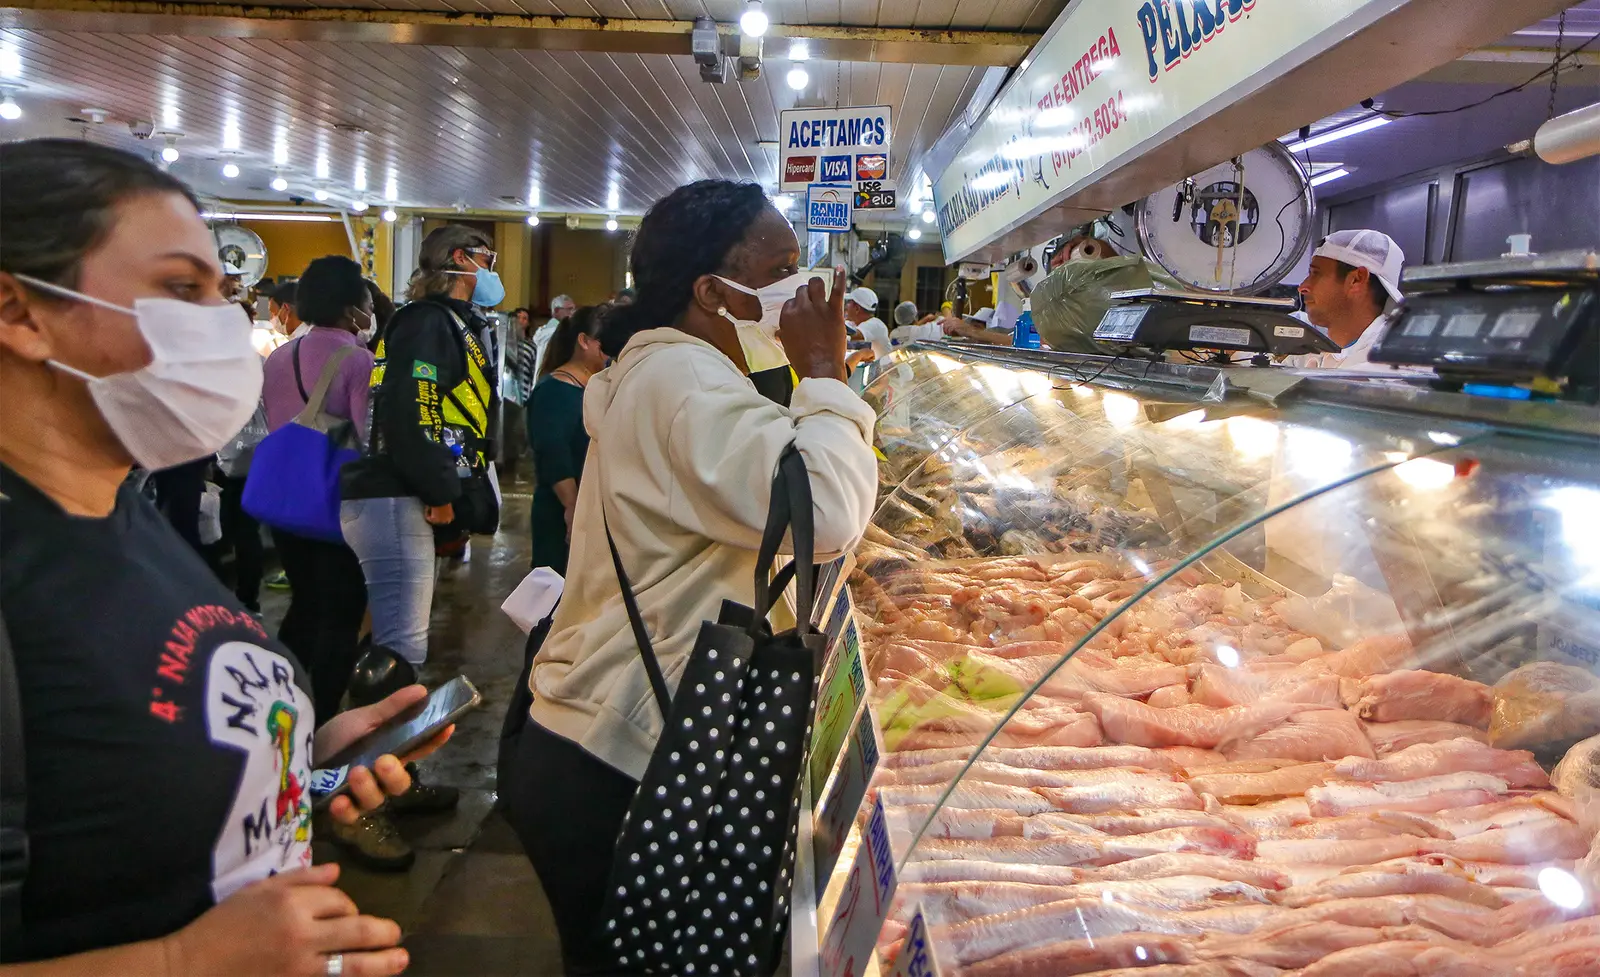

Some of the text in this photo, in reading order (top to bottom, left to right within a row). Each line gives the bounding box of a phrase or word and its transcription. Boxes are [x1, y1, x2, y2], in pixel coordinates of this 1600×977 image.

[788, 117, 885, 148] ACEITAMOS
[787, 162, 815, 174] Hipercard
[824, 161, 849, 176] VISA
[811, 202, 848, 217] BANRI
[810, 217, 848, 227] COMPRAS
